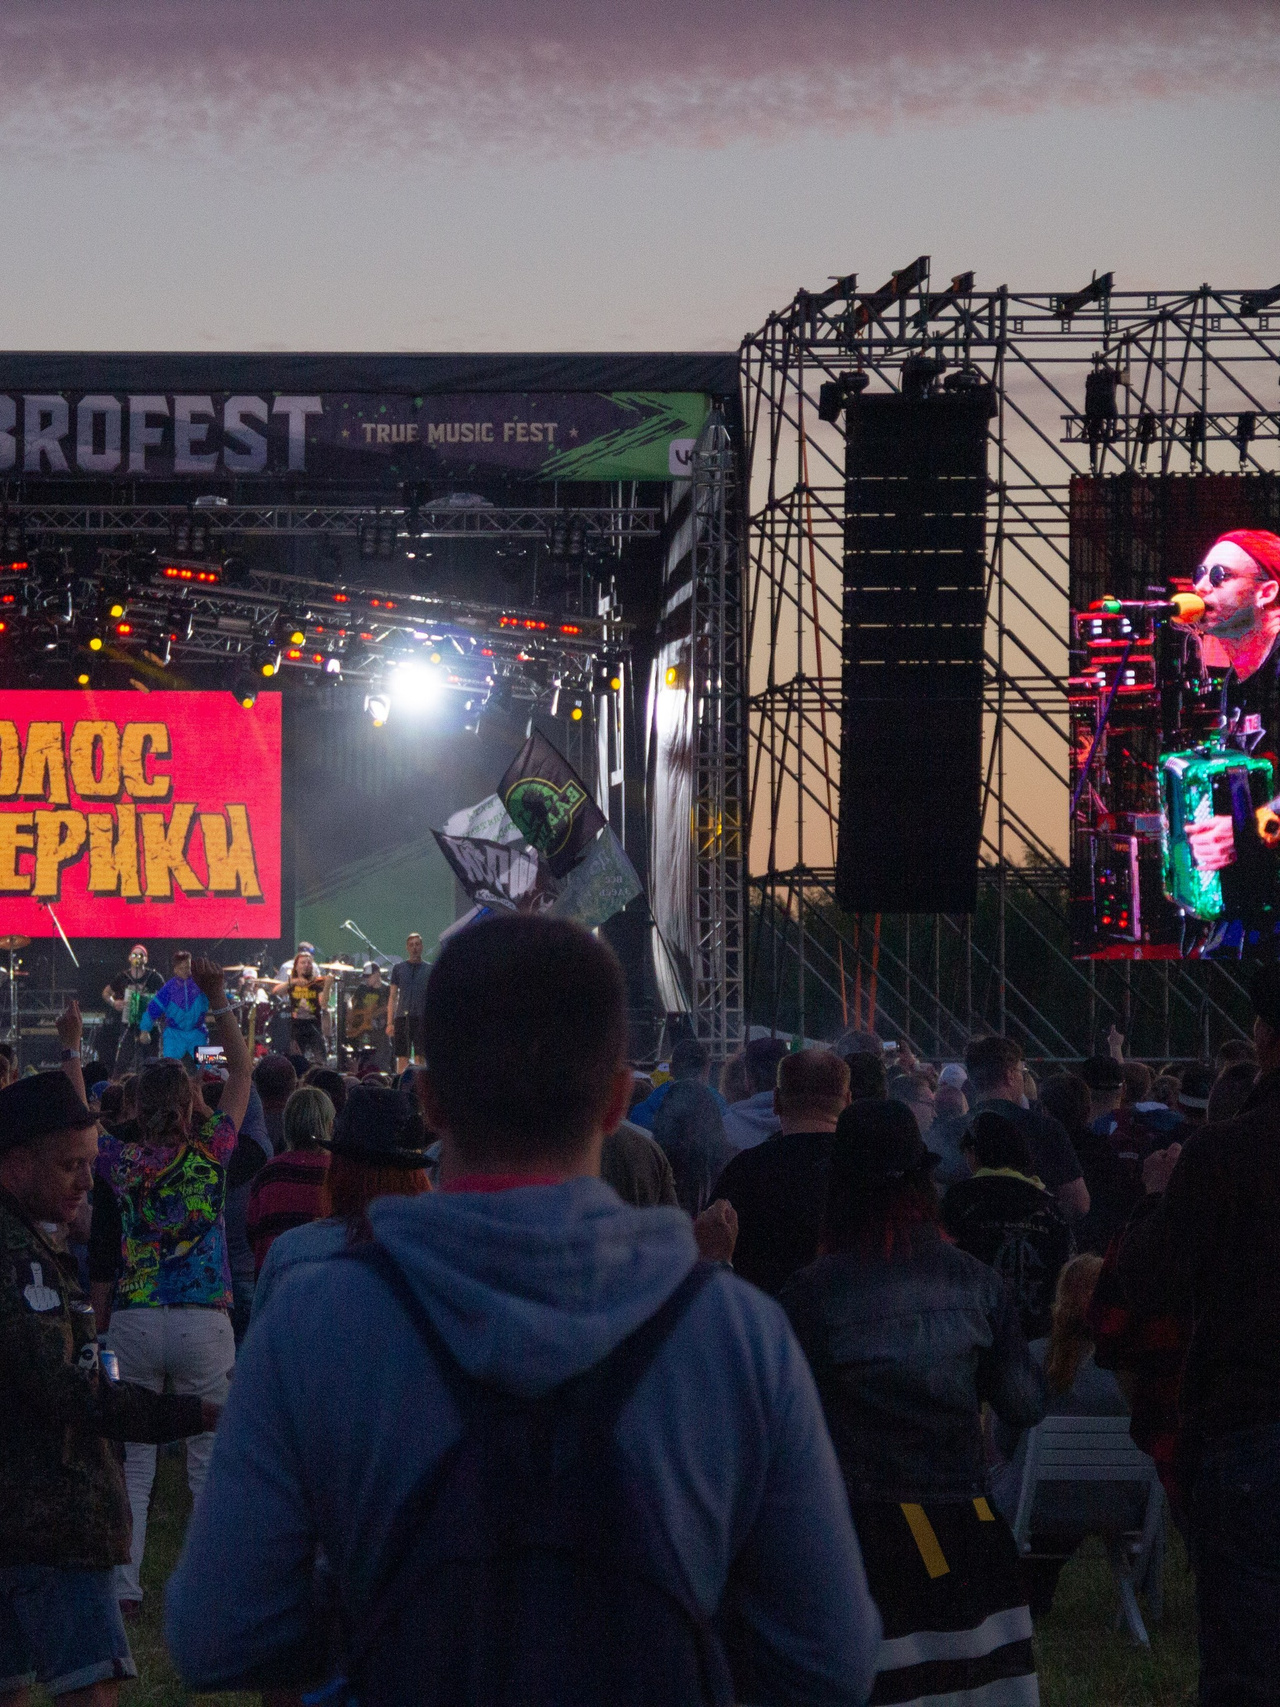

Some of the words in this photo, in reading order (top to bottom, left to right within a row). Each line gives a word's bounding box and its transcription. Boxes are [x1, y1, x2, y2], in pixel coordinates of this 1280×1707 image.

[362, 422, 419, 444] TRUE
[427, 422, 495, 443] MUSIC
[503, 422, 558, 443] FEST
